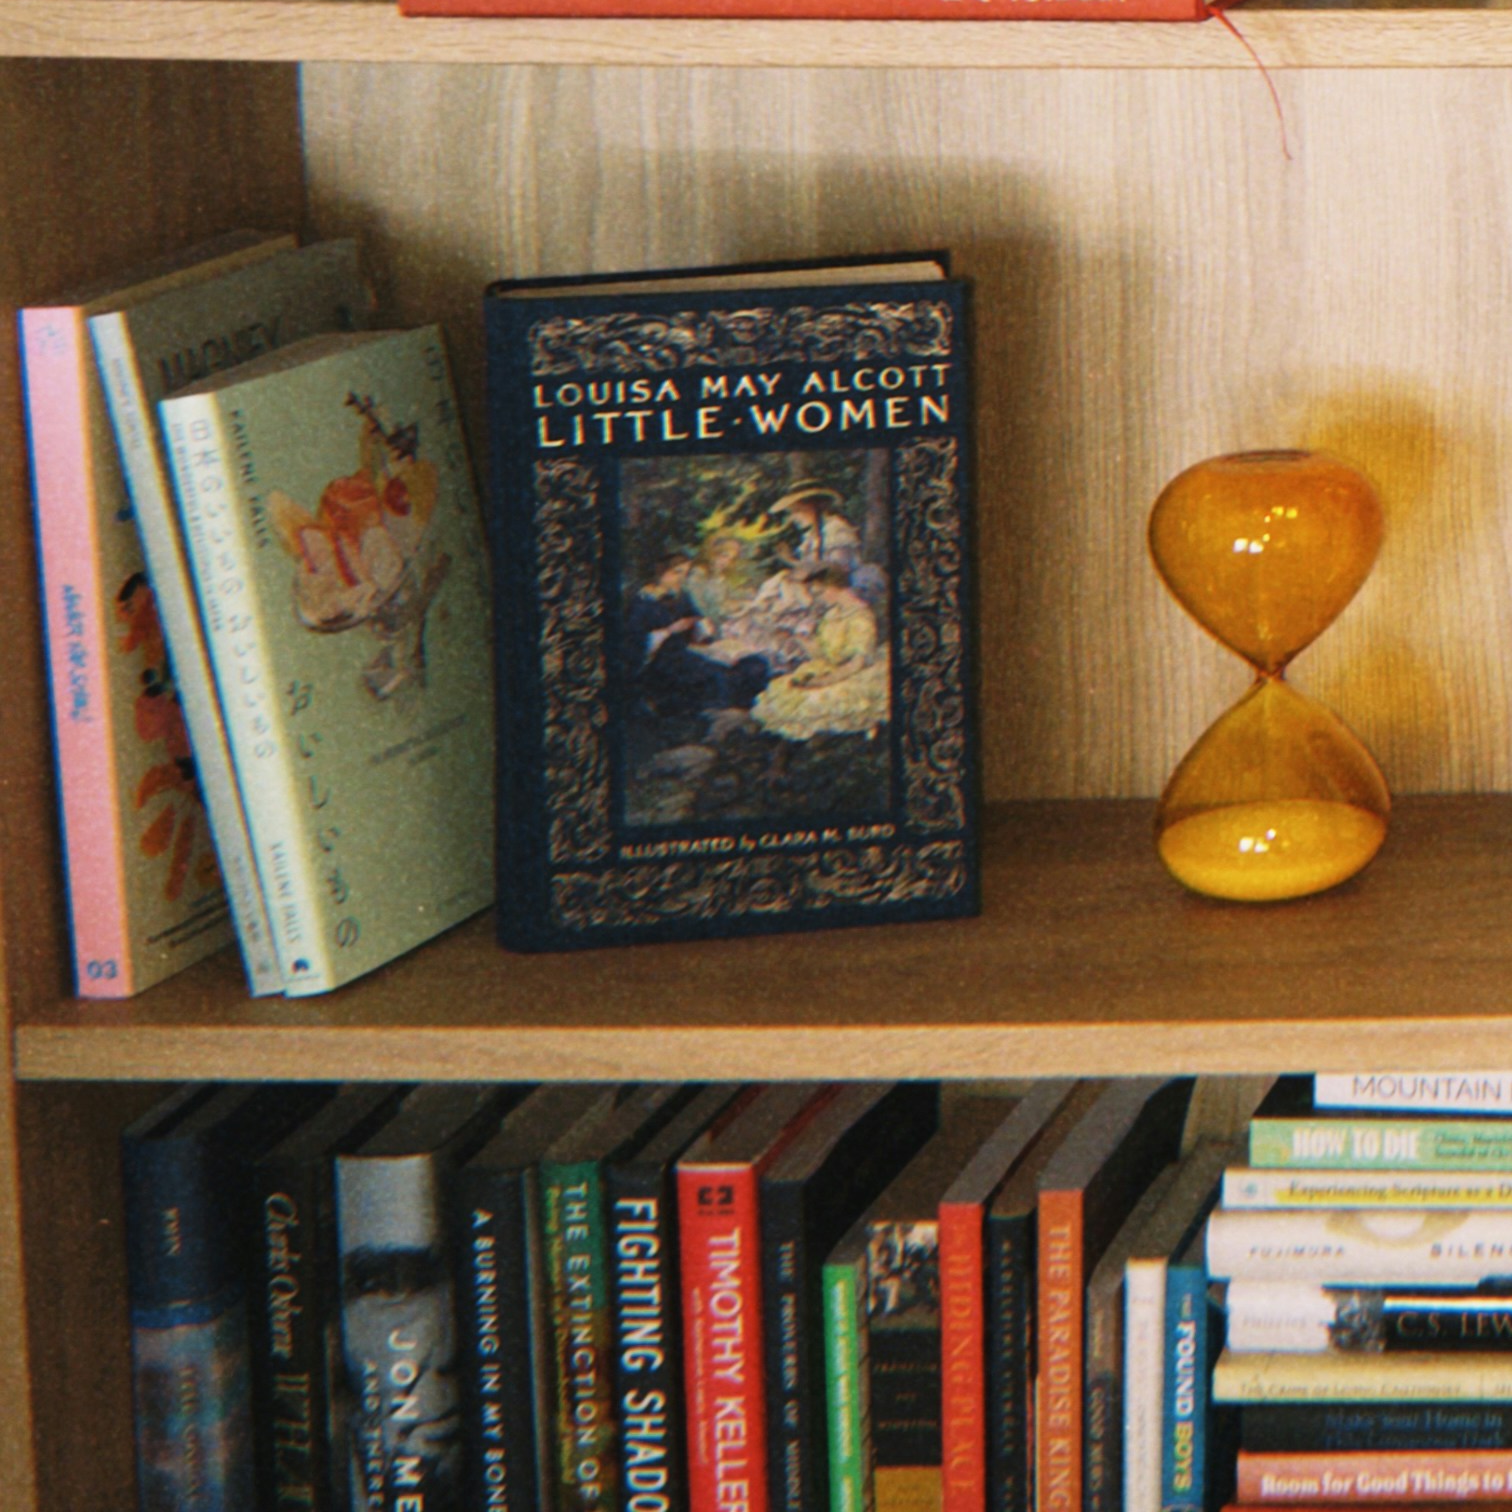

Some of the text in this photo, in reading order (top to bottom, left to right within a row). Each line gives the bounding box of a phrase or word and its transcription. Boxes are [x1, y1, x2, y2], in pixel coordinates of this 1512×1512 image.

[534, 364, 952, 406] LOUISA MAY ALCOTT
[538, 396, 952, 449] LITTLE WOMEN
[1353, 1076, 1501, 1103] MOUNTAIN
[616, 1198, 662, 1371] FIGHTING
[708, 1230, 743, 1383] TIMOTHY
[564, 1182, 598, 1501] THE EXTINCTION OF
[1174, 1320, 1195, 1492] FOUND BOYS
[1260, 1473, 1319, 1496] Room
[1322, 1472, 1353, 1494] for
[1356, 1472, 1408, 1494] Good
[1411, 1471, 1479, 1495] Things
[1483, 1470, 1504, 1491] to
